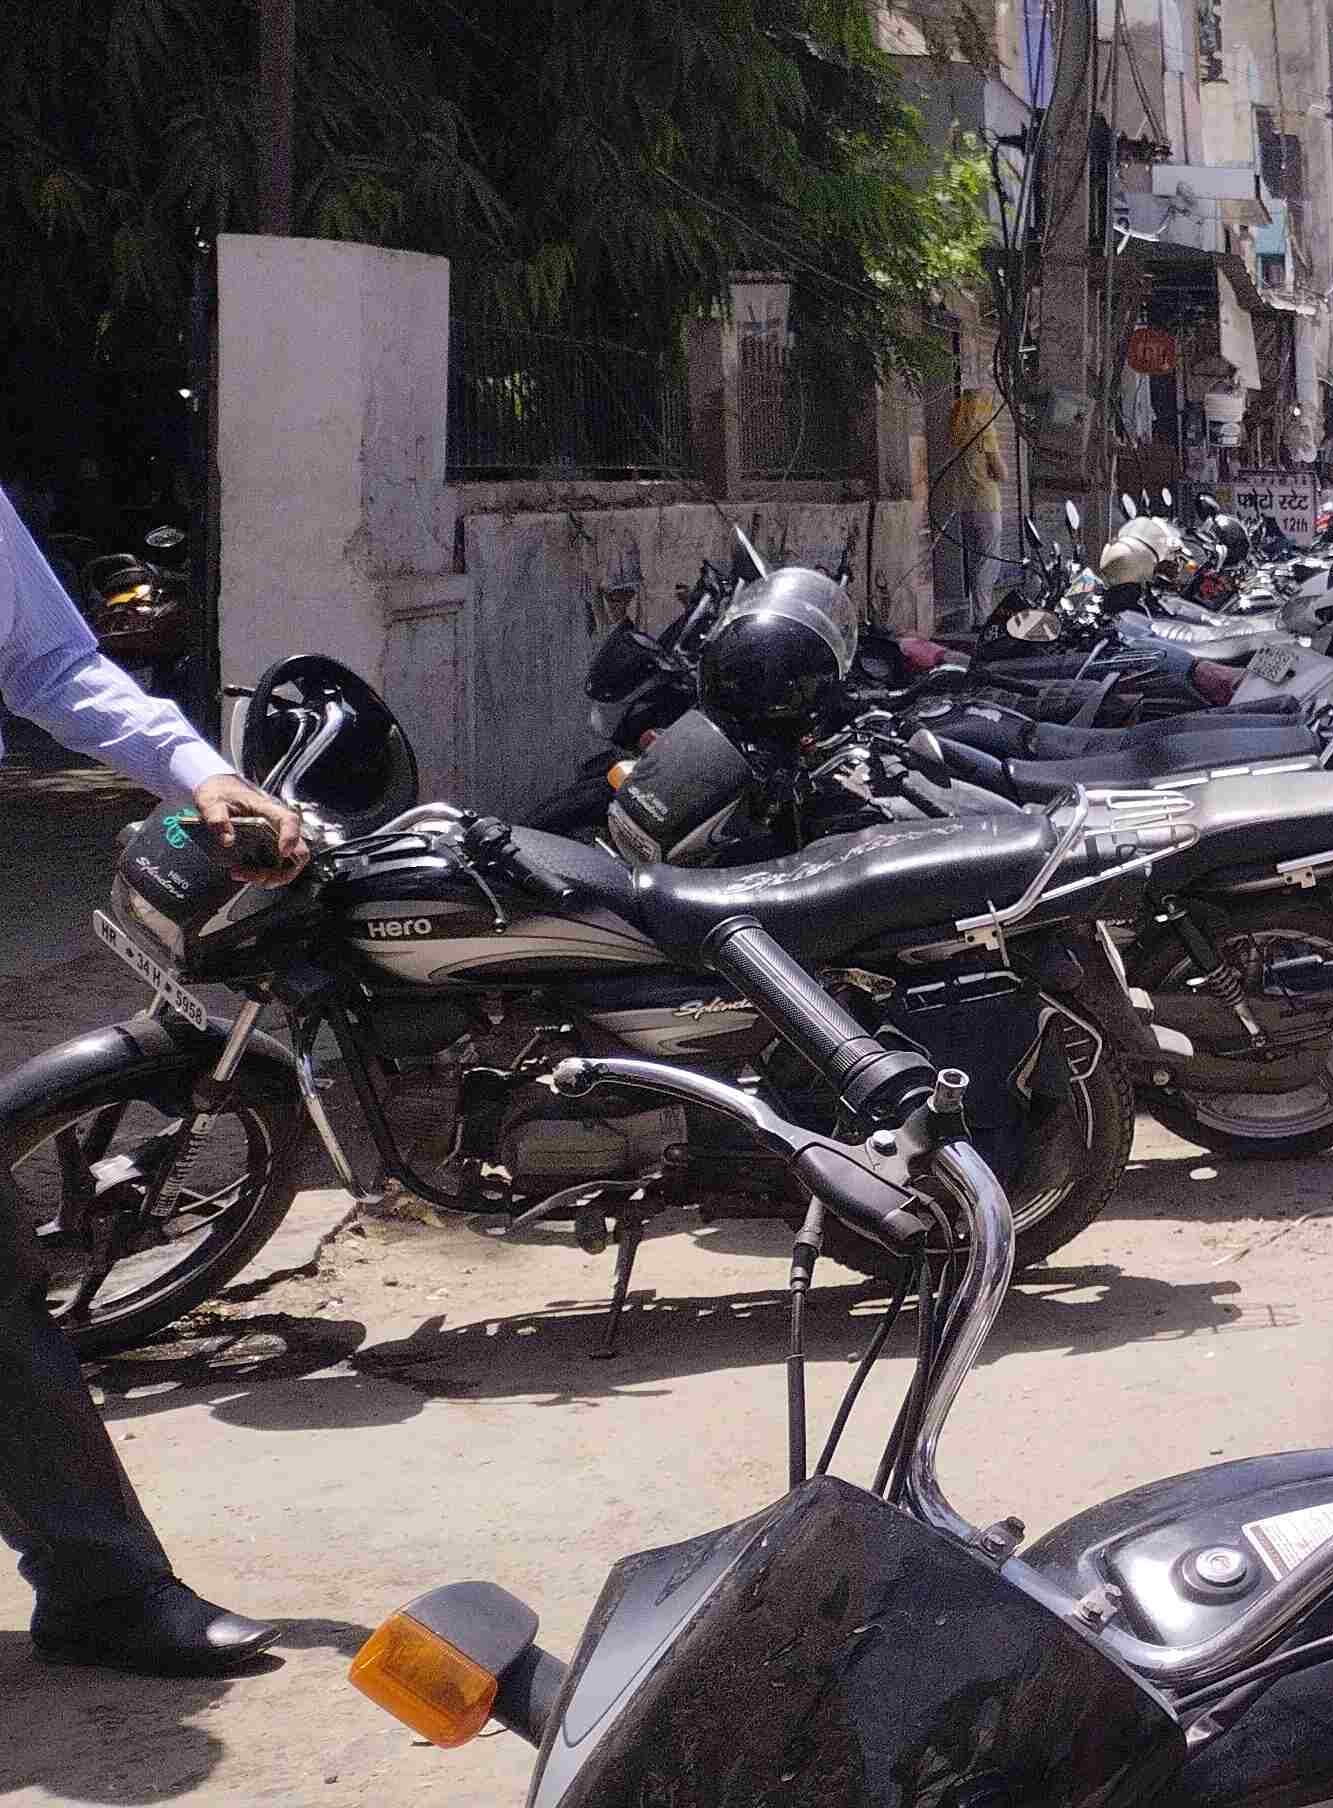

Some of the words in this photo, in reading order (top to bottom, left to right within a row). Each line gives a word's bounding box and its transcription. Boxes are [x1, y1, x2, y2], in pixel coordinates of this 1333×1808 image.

[1279, 489, 1309, 511] स्टेट
[368, 918, 432, 938] Hero
[101, 921, 117, 946] HR
[175, 992, 203, 1024] 5958
